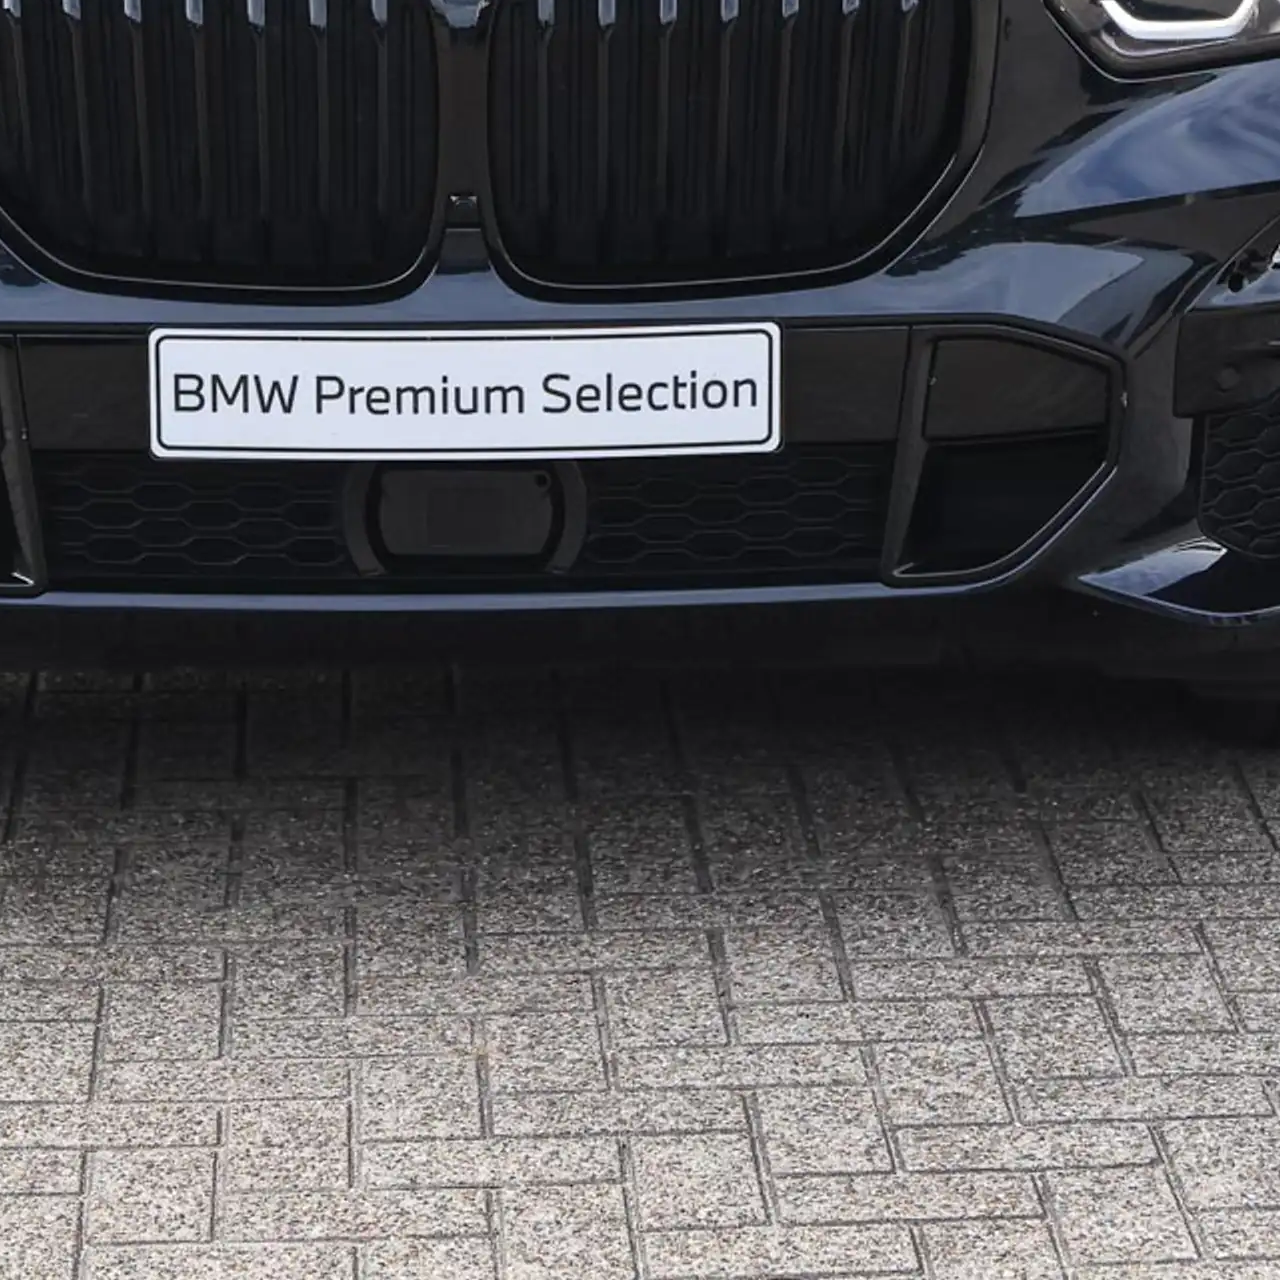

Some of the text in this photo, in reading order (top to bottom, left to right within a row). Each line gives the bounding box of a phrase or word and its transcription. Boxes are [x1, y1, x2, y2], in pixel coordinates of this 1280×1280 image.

[173, 369, 758, 416] BMW Premium Selection
